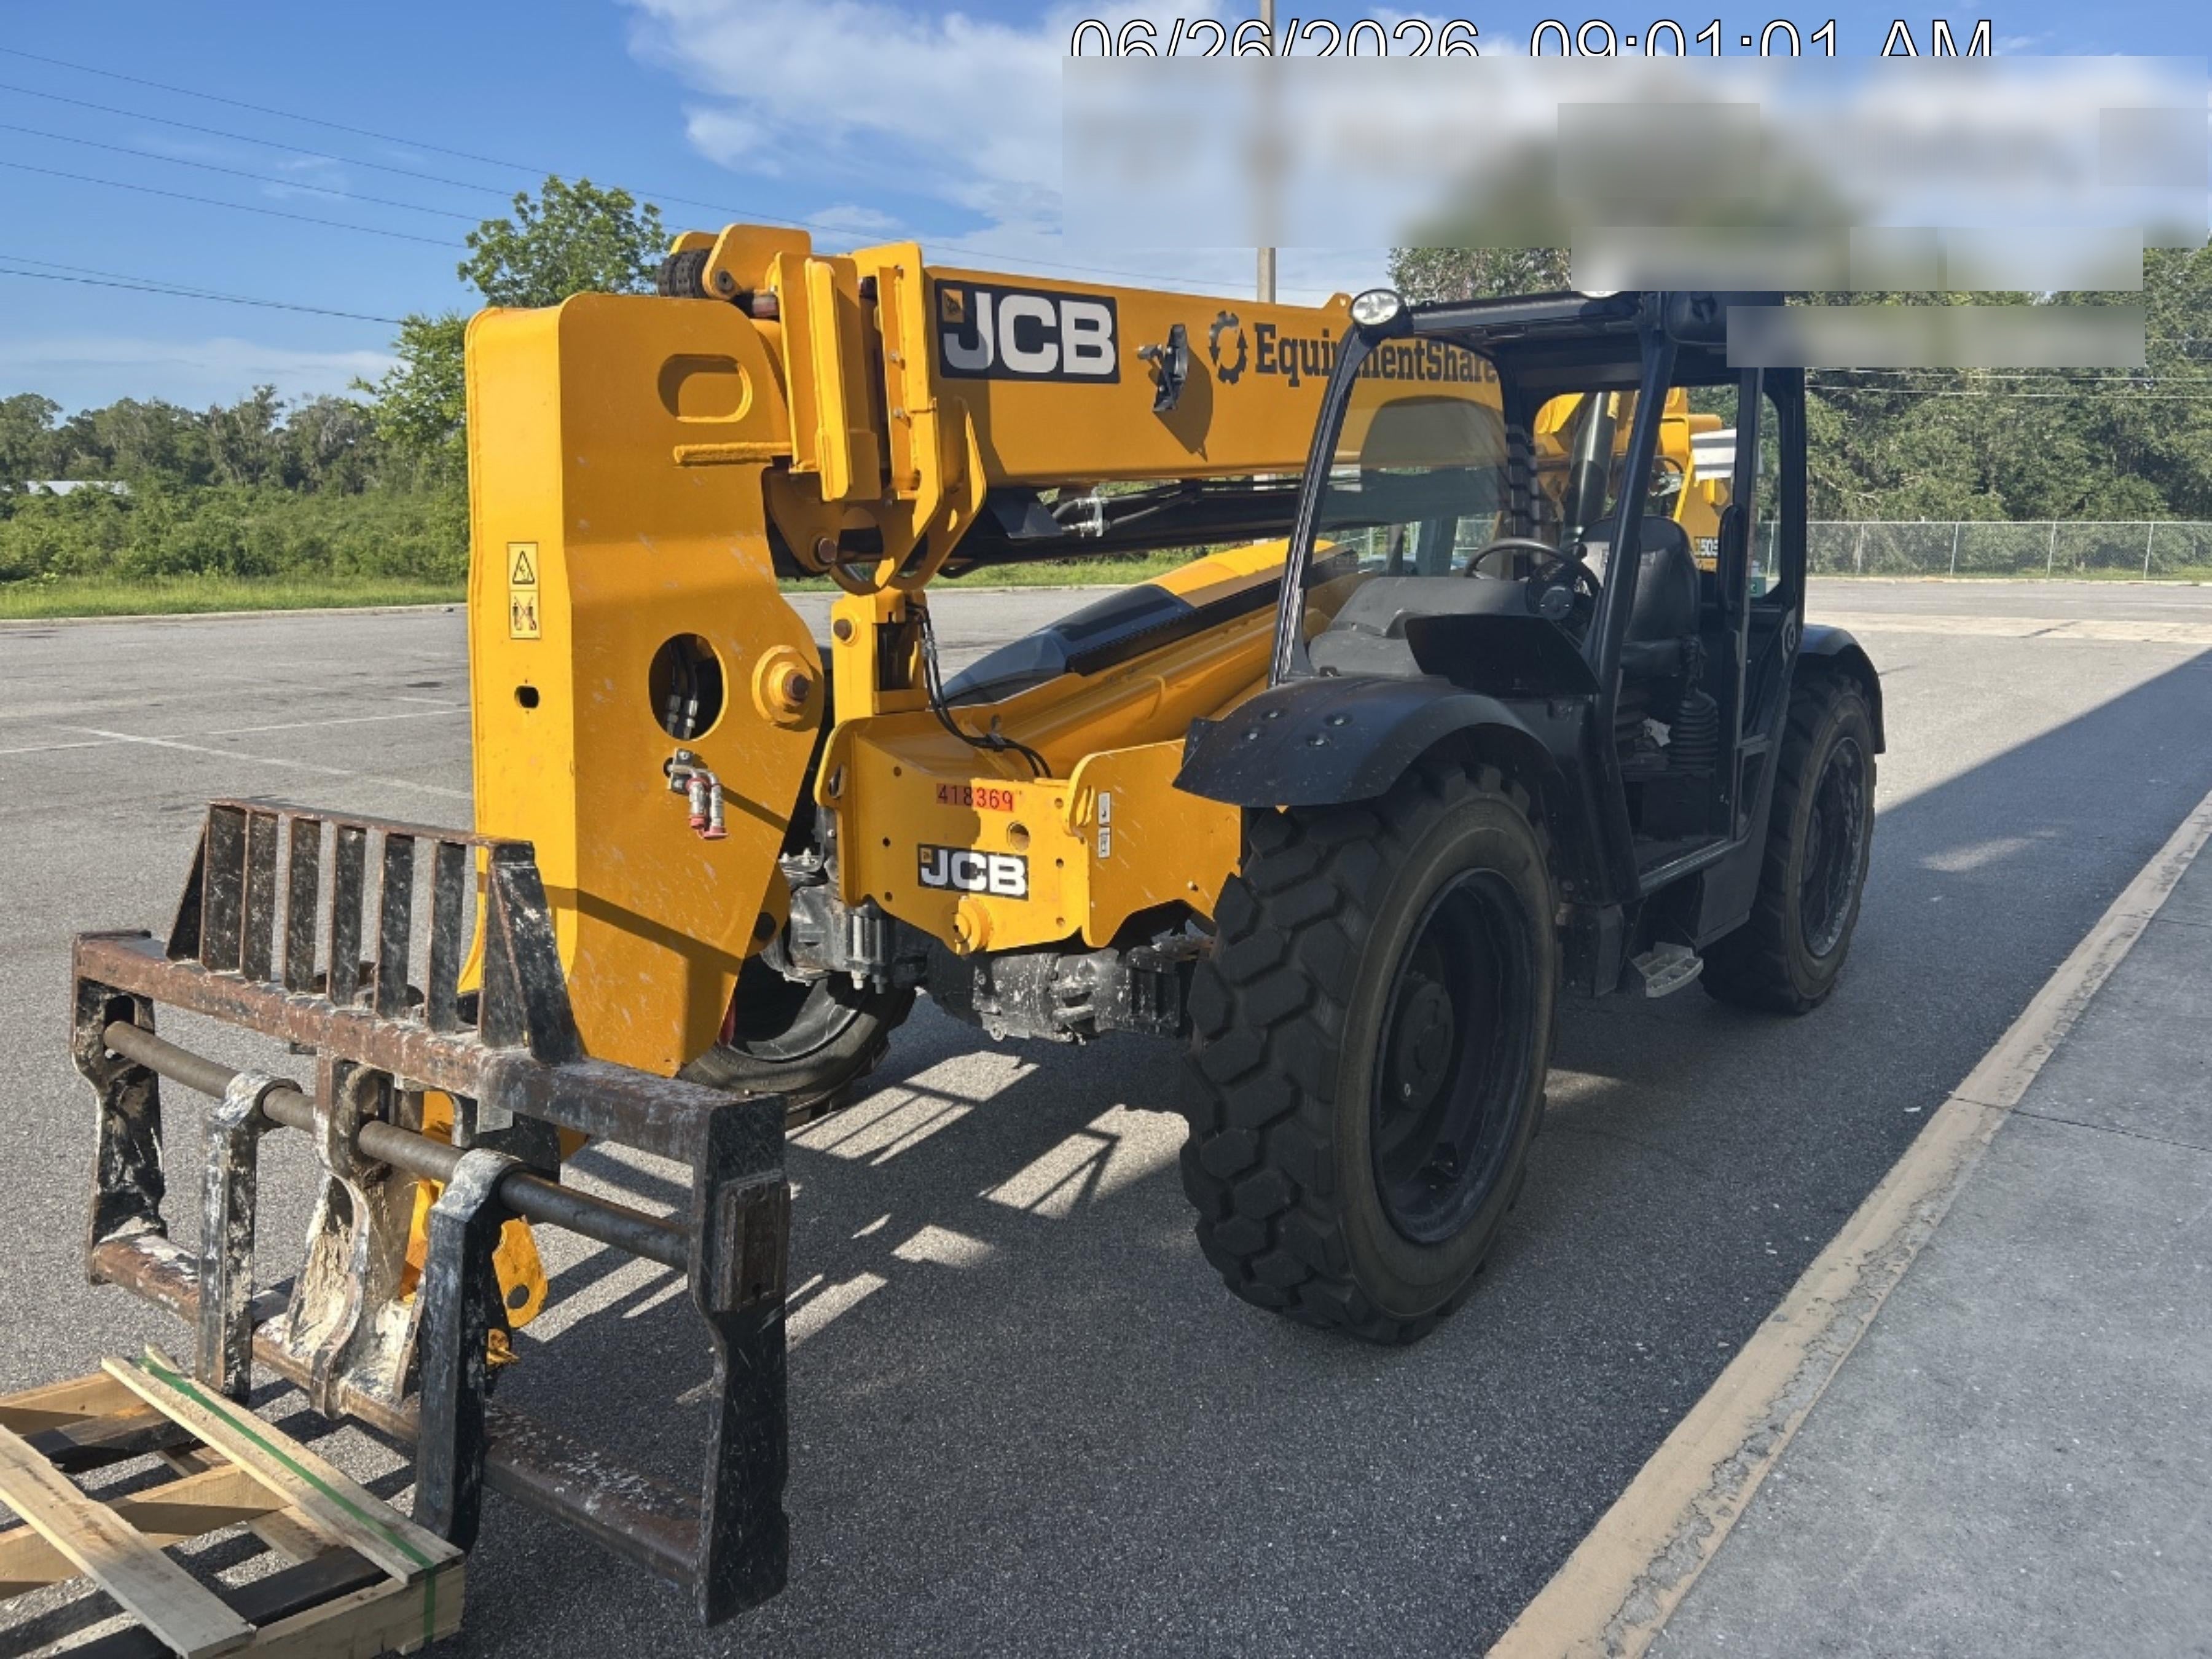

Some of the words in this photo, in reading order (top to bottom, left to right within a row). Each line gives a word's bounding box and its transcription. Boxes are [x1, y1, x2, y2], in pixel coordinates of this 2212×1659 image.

[943, 291, 1116, 374] JCB
[938, 785, 1013, 811] 418369
[921, 849, 1026, 896] JCB
